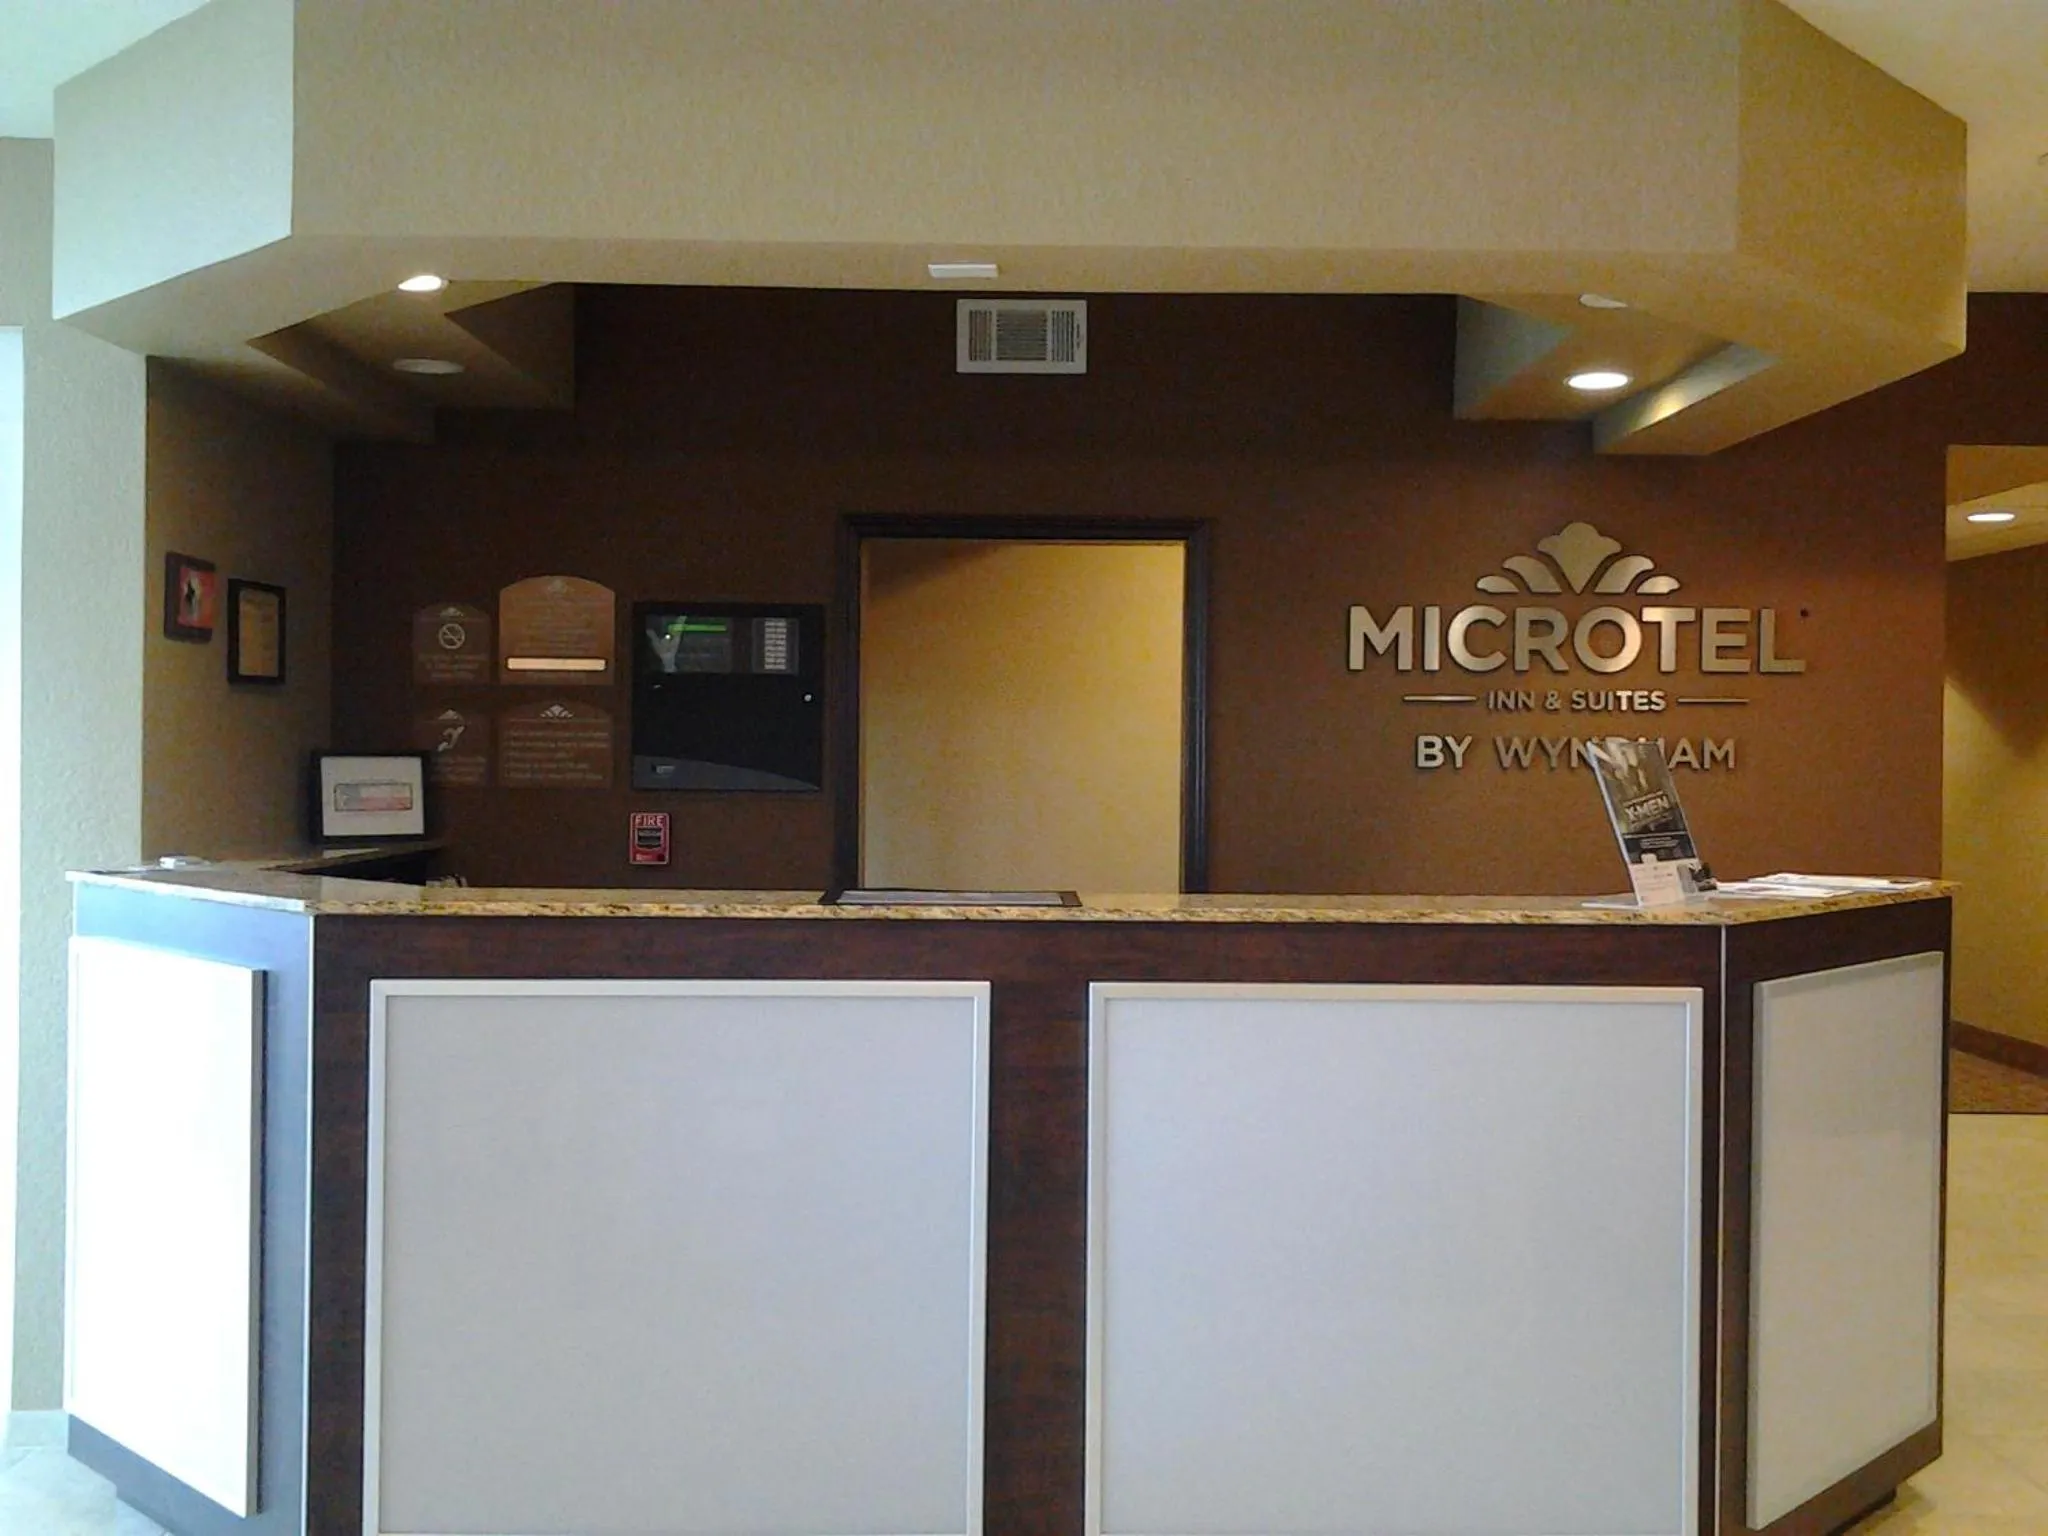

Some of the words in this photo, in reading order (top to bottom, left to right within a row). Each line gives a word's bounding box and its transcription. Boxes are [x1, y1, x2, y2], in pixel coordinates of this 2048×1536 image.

[1347, 604, 1806, 674] MICROTEL
[1487, 689, 1535, 711] INN
[1544, 689, 1561, 711] &
[1571, 690, 1667, 711] SUITES
[1416, 734, 1472, 770] BY
[1495, 736, 1737, 770] WYNAM
[634, 815, 666, 827] FIRE
